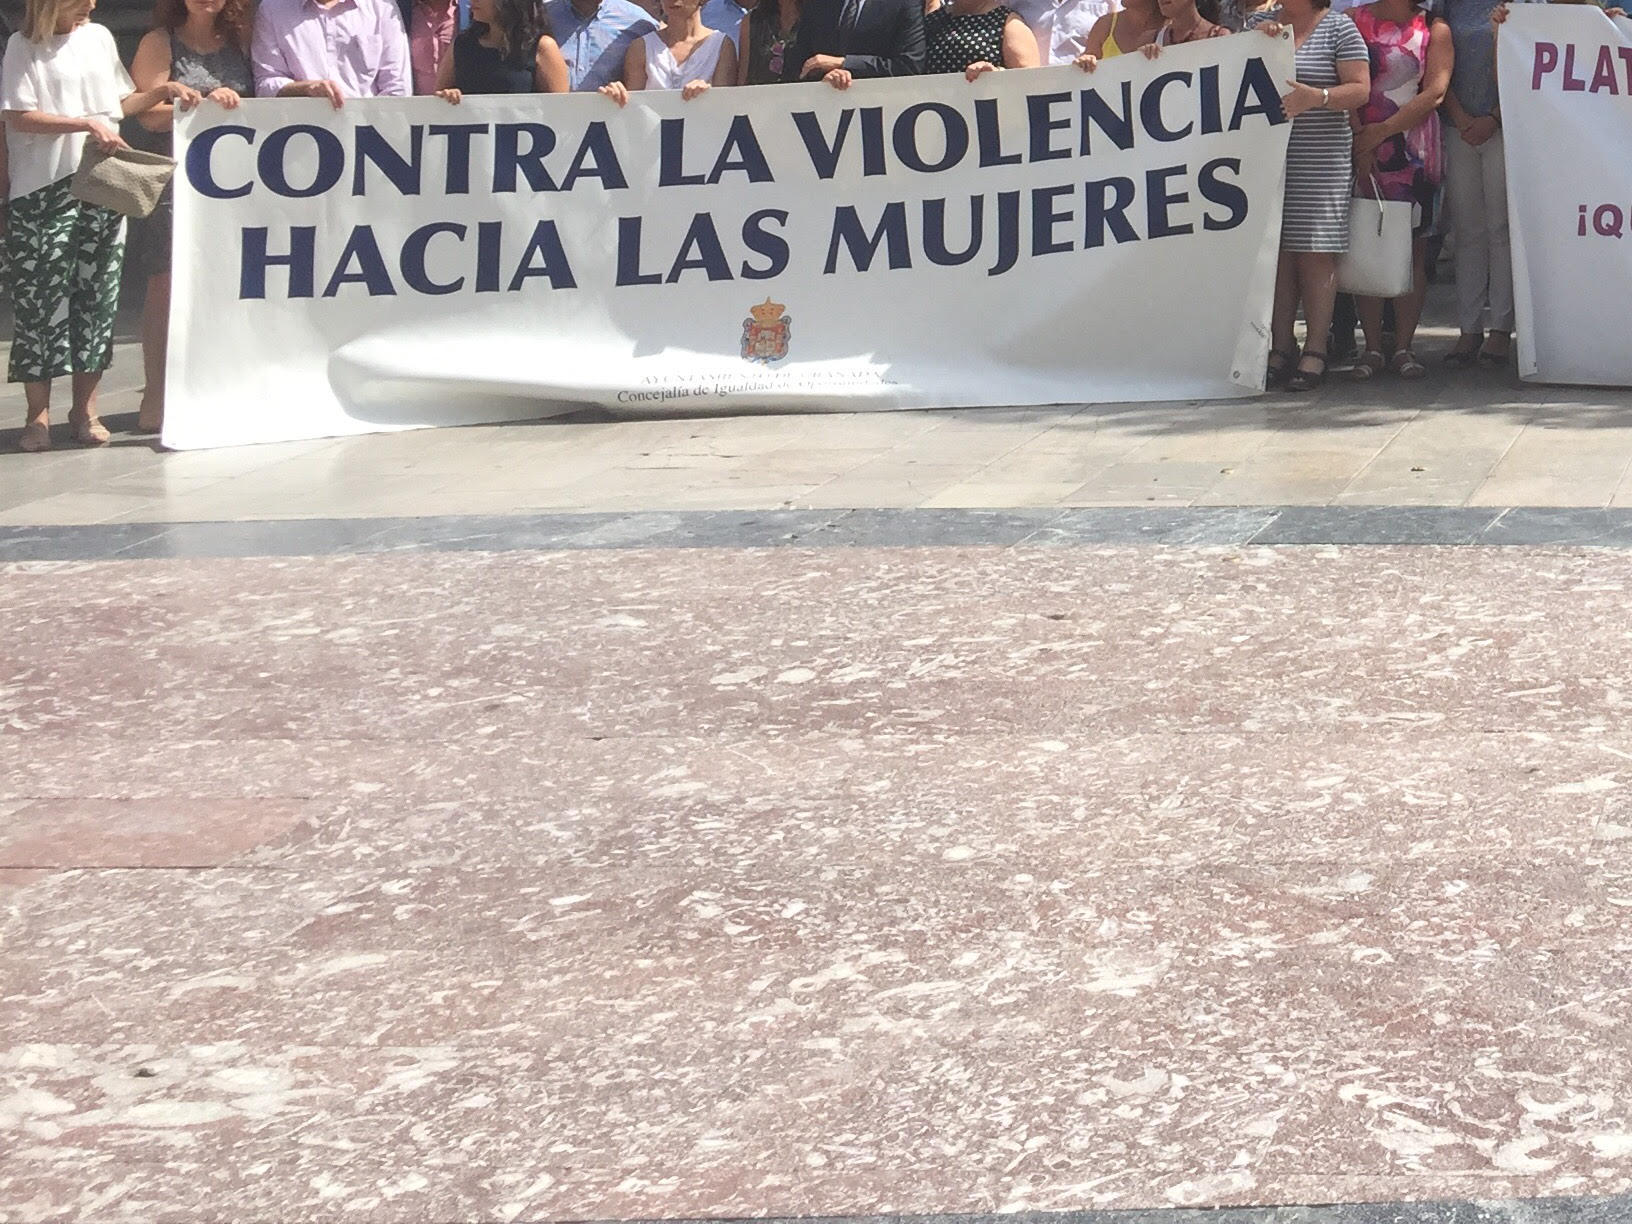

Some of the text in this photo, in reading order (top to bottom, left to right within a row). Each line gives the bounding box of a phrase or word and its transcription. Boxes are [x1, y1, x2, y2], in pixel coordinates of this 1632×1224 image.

[185, 56, 1290, 199] CONTRA LA VIOLENCIA
[239, 157, 1249, 300] HACIA LAS MUJERES
[617, 381, 690, 404] Concejalía
[692, 384, 709, 397] de
